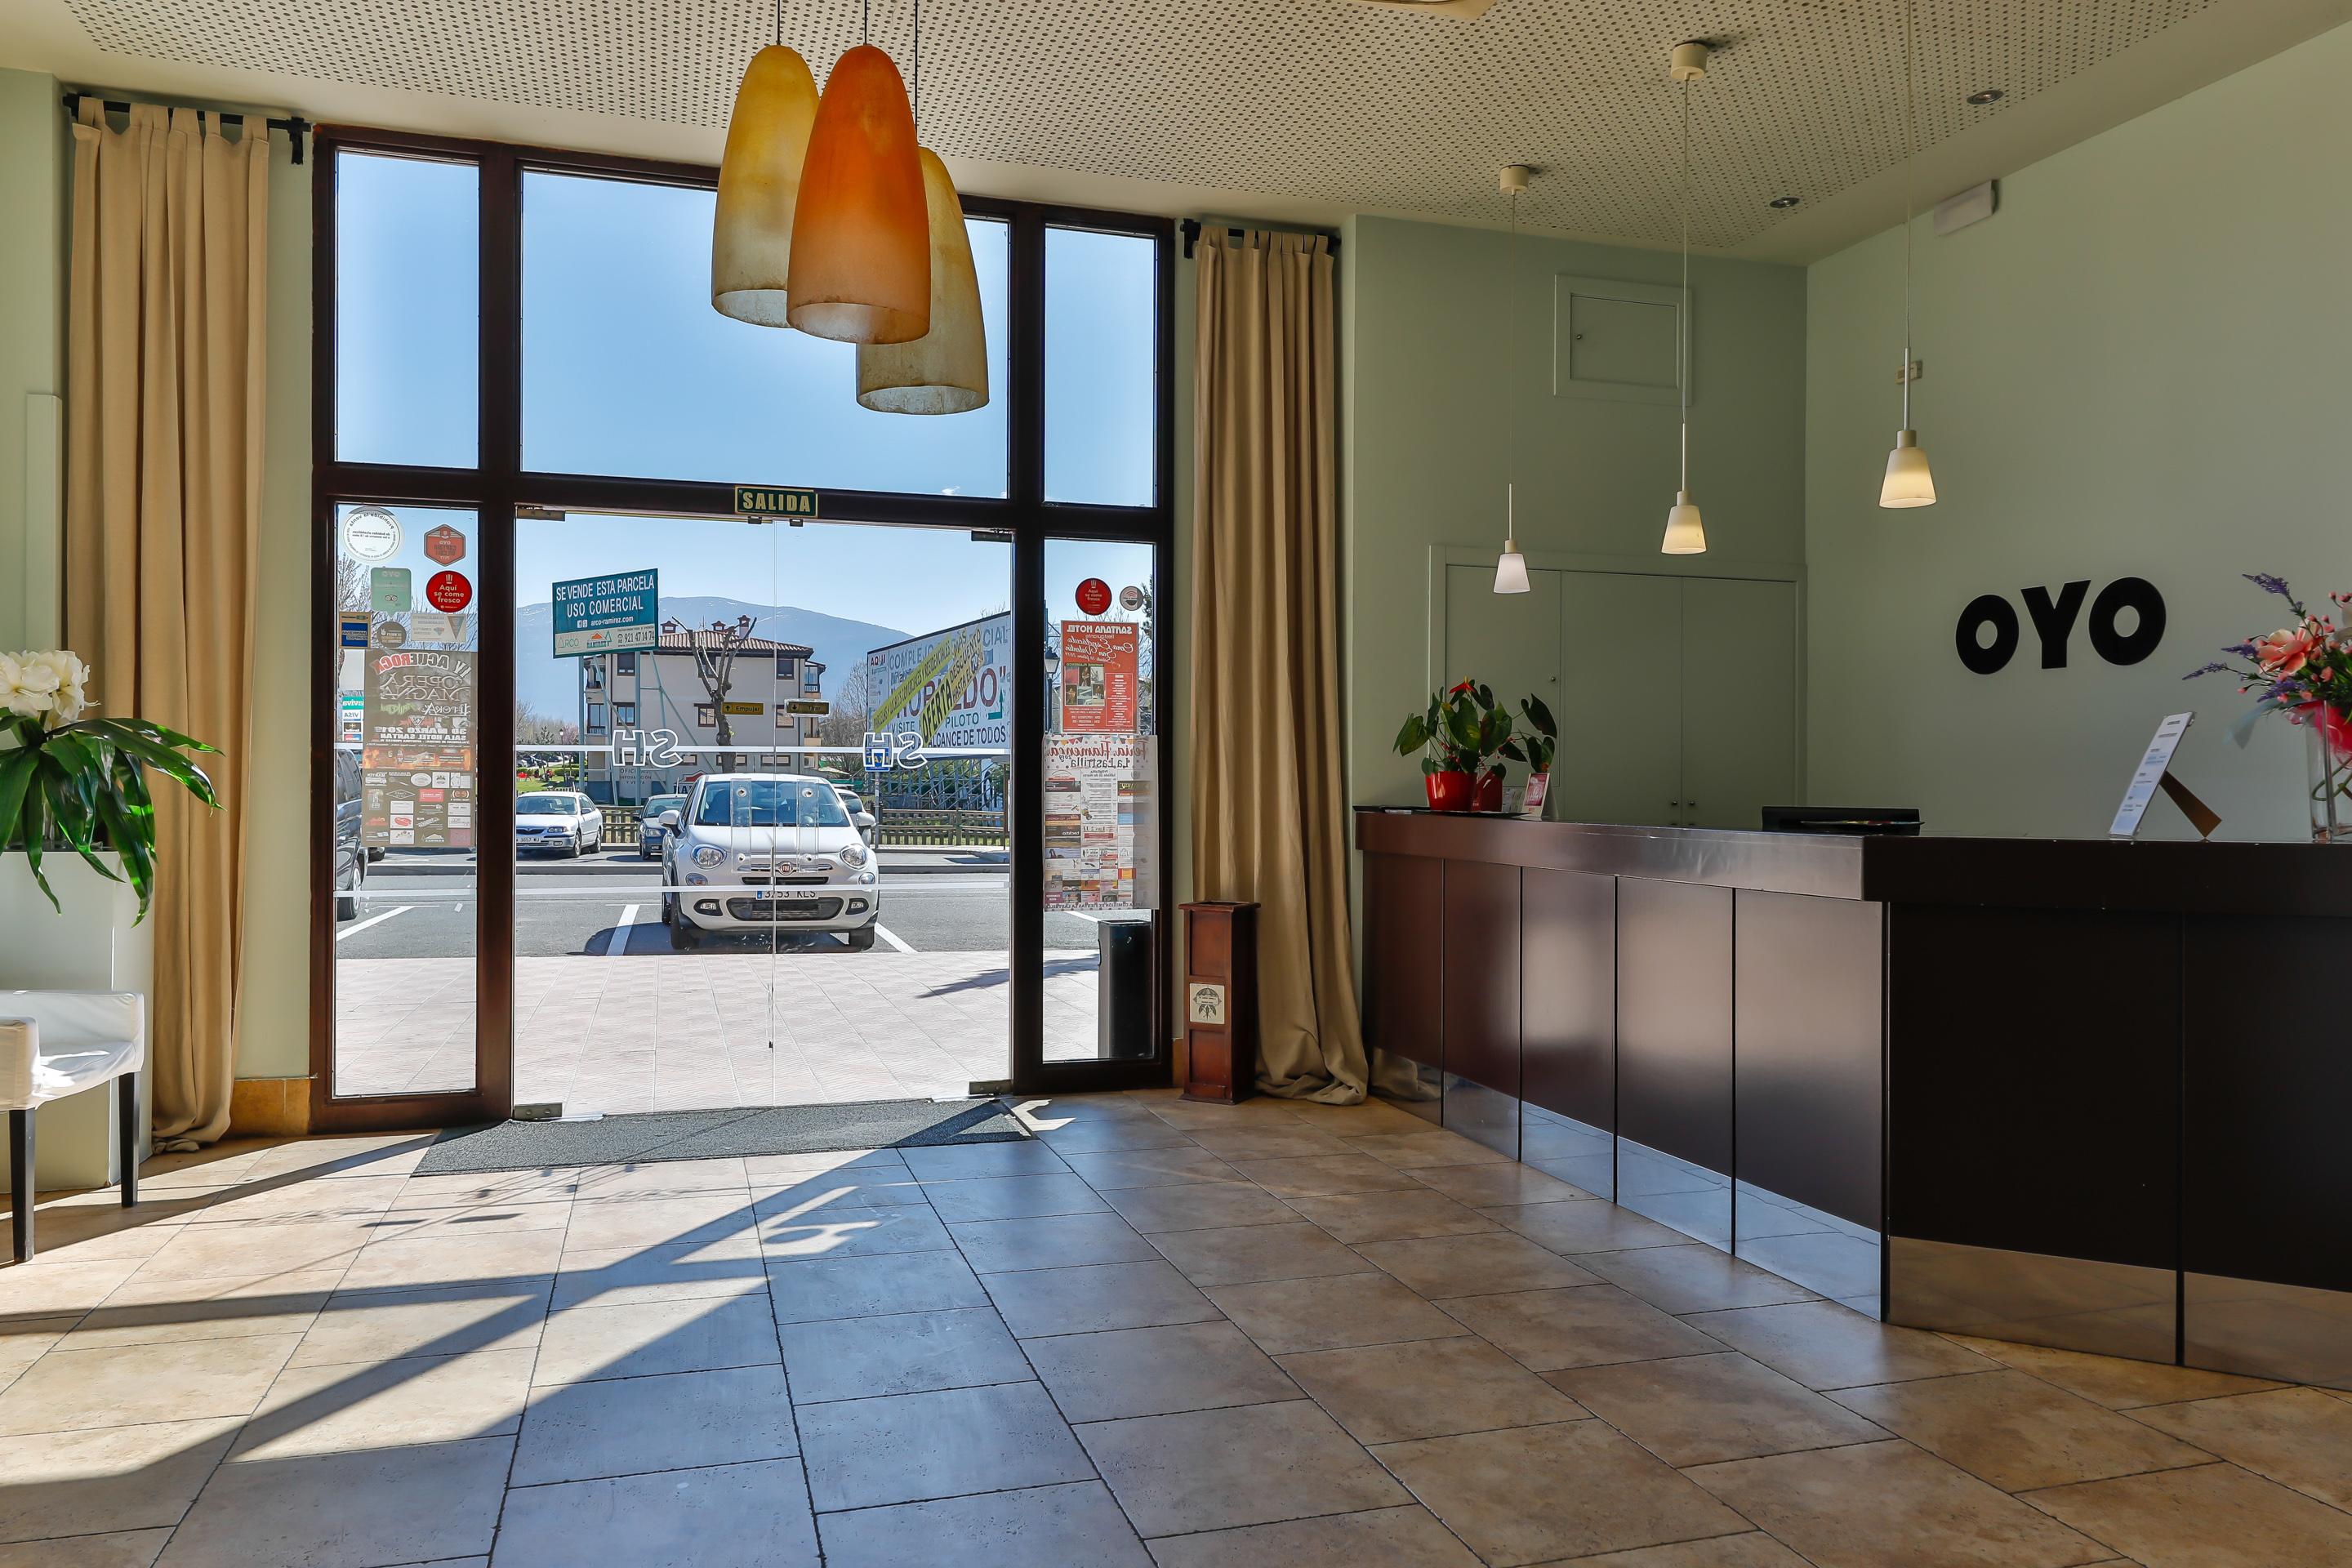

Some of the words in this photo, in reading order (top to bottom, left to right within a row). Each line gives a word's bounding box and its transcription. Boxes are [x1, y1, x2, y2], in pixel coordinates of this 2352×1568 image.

[742, 492, 811, 513] SALIDA
[556, 586, 566, 601] SE
[567, 583, 594, 599] VENDE
[597, 580, 616, 596] ESTA
[617, 574, 655, 594] PARCELA
[567, 602, 586, 618] USO
[589, 595, 644, 615] COMERCIAL
[590, 617, 634, 626] arco-ramirez.com
[1955, 576, 2167, 675] OYO
[624, 632, 633, 643] 921
[922, 678, 953, 744] OFERTA
[950, 629, 981, 683] DESCUENTO
[892, 720, 915, 733] VISITE
[945, 712, 979, 728] PILOTO
[928, 730, 962, 748] ALCANCE
[963, 729, 974, 746] DE
[976, 725, 1006, 744] TODOS
